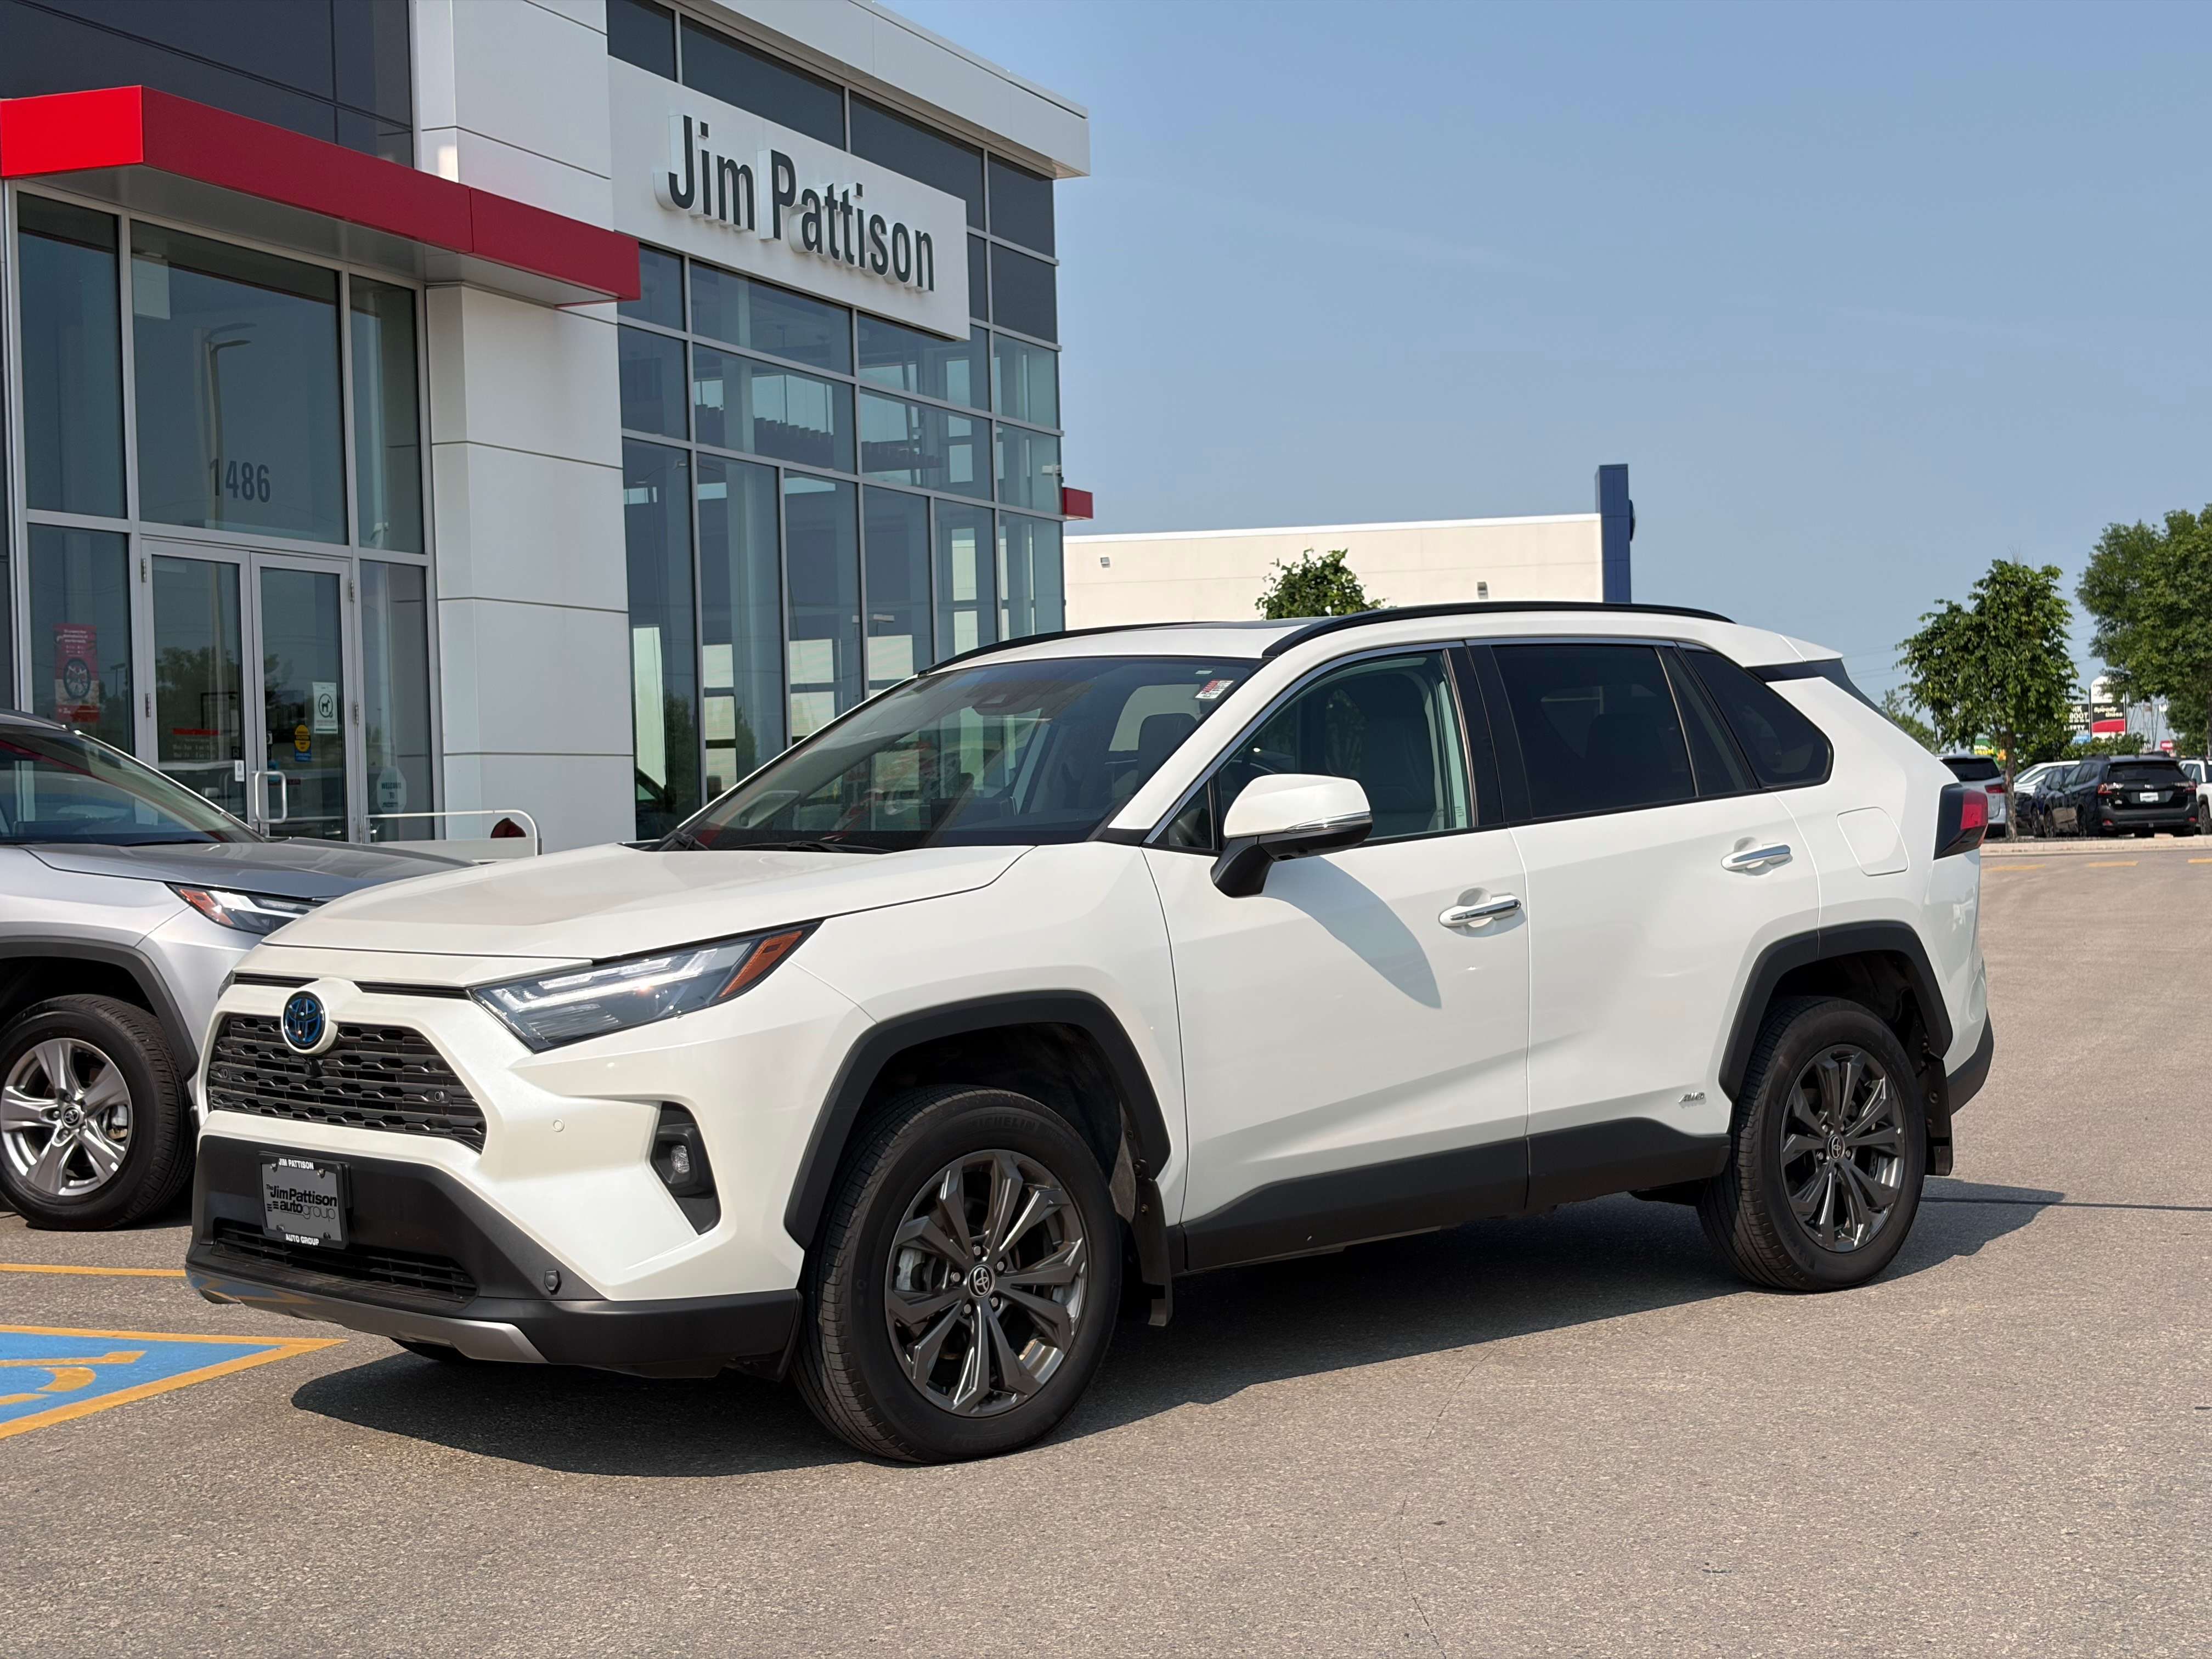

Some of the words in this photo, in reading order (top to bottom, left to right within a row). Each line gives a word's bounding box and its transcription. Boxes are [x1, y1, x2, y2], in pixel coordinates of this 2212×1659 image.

[668, 115, 755, 232] Jim
[770, 149, 934, 292] Pattison
[210, 459, 270, 503] 1486
[278, 1158, 287, 1167] JIM
[288, 1159, 314, 1170] PATTISON
[285, 1233, 300, 1243] AUTO
[300, 1236, 319, 1246] GROUP
